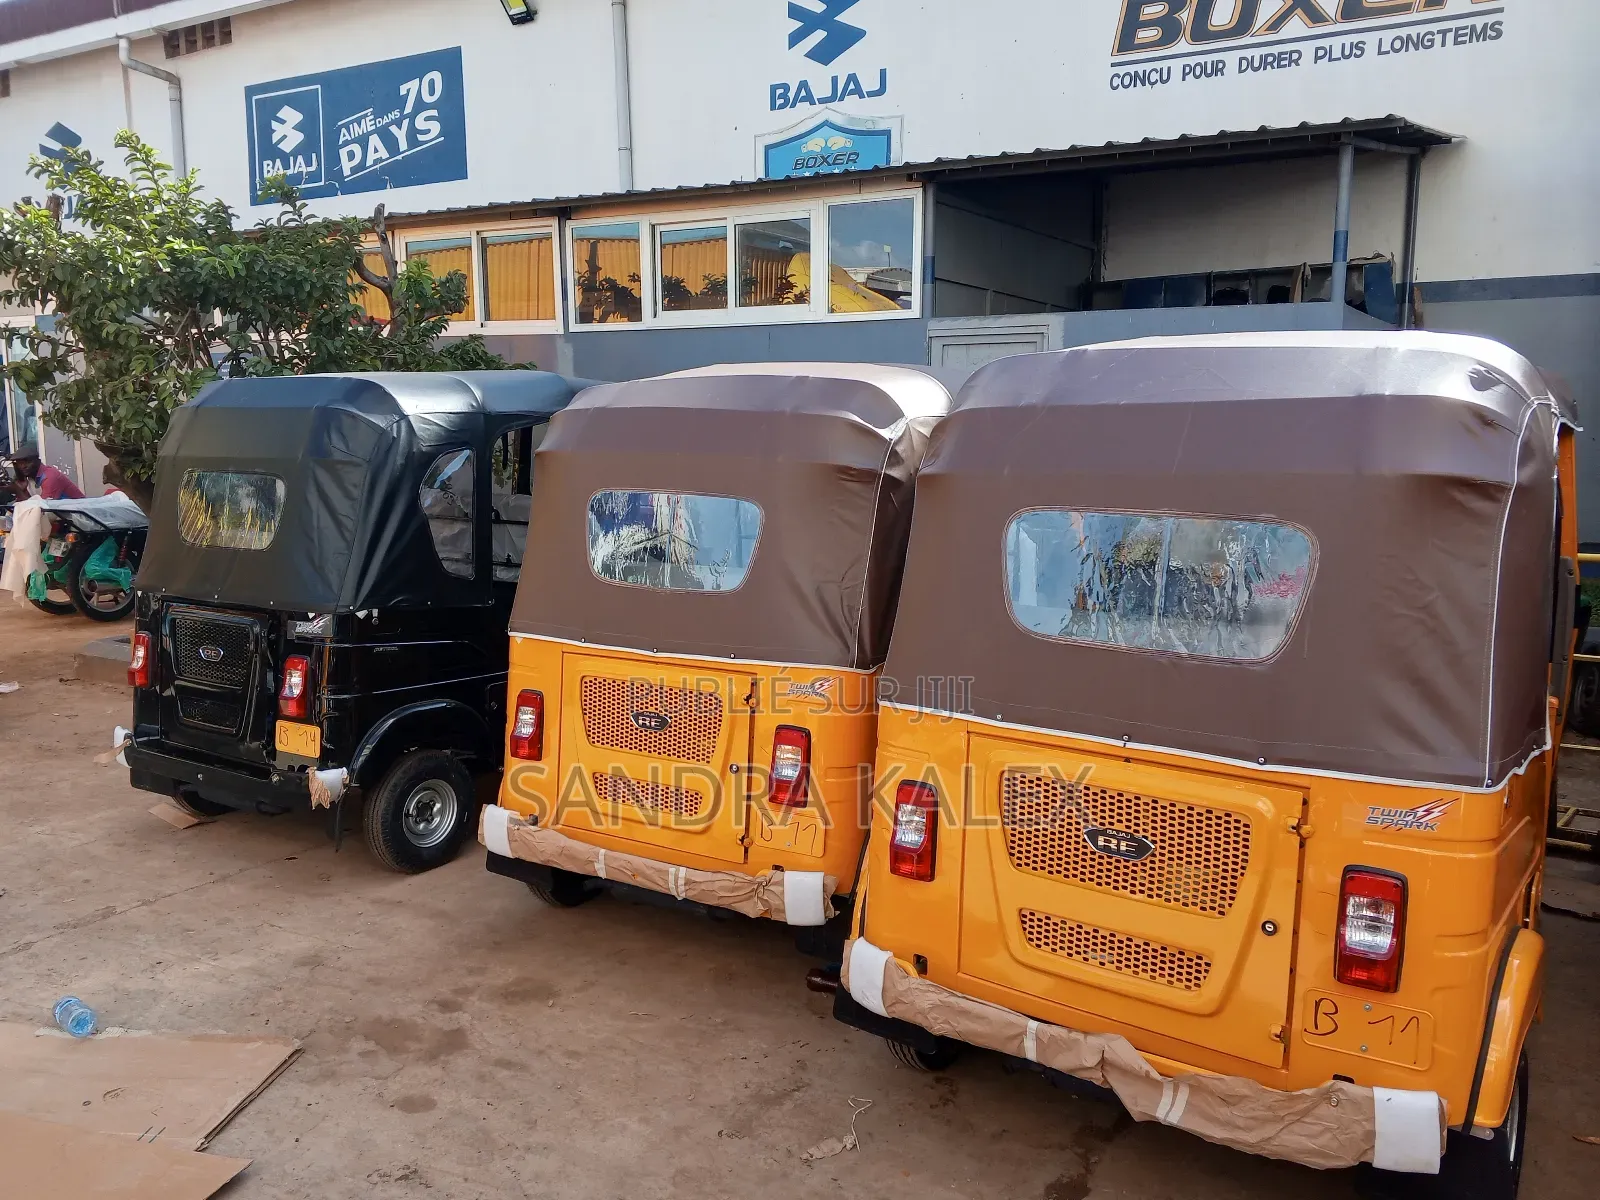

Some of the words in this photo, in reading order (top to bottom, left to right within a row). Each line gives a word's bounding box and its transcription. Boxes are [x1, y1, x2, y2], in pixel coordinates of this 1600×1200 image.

[1109, 66, 1171, 90] CONÇU
[1181, 59, 1226, 81] POUR
[1237, 49, 1303, 74] DURER
[1313, 40, 1367, 64] PLUS
[1377, 20, 1504, 56] LONGTEMS
[769, 68, 887, 111] BAJAJ
[338, 112, 376, 145] AIMÉ
[376, 109, 400, 128] DANS
[399, 70, 443, 116] 70
[338, 109, 442, 177] PAYS
[263, 152, 318, 178] BAJAJ
[792, 151, 860, 171] BOXER
[638, 716, 662, 729] RE
[1365, 816, 1440, 832] SPARK
[1368, 806, 1418, 820] TWIN
[1097, 835, 1138, 857] RE
[1106, 829, 1131, 839] BAJAJ
[1304, 997, 1339, 1036] B
